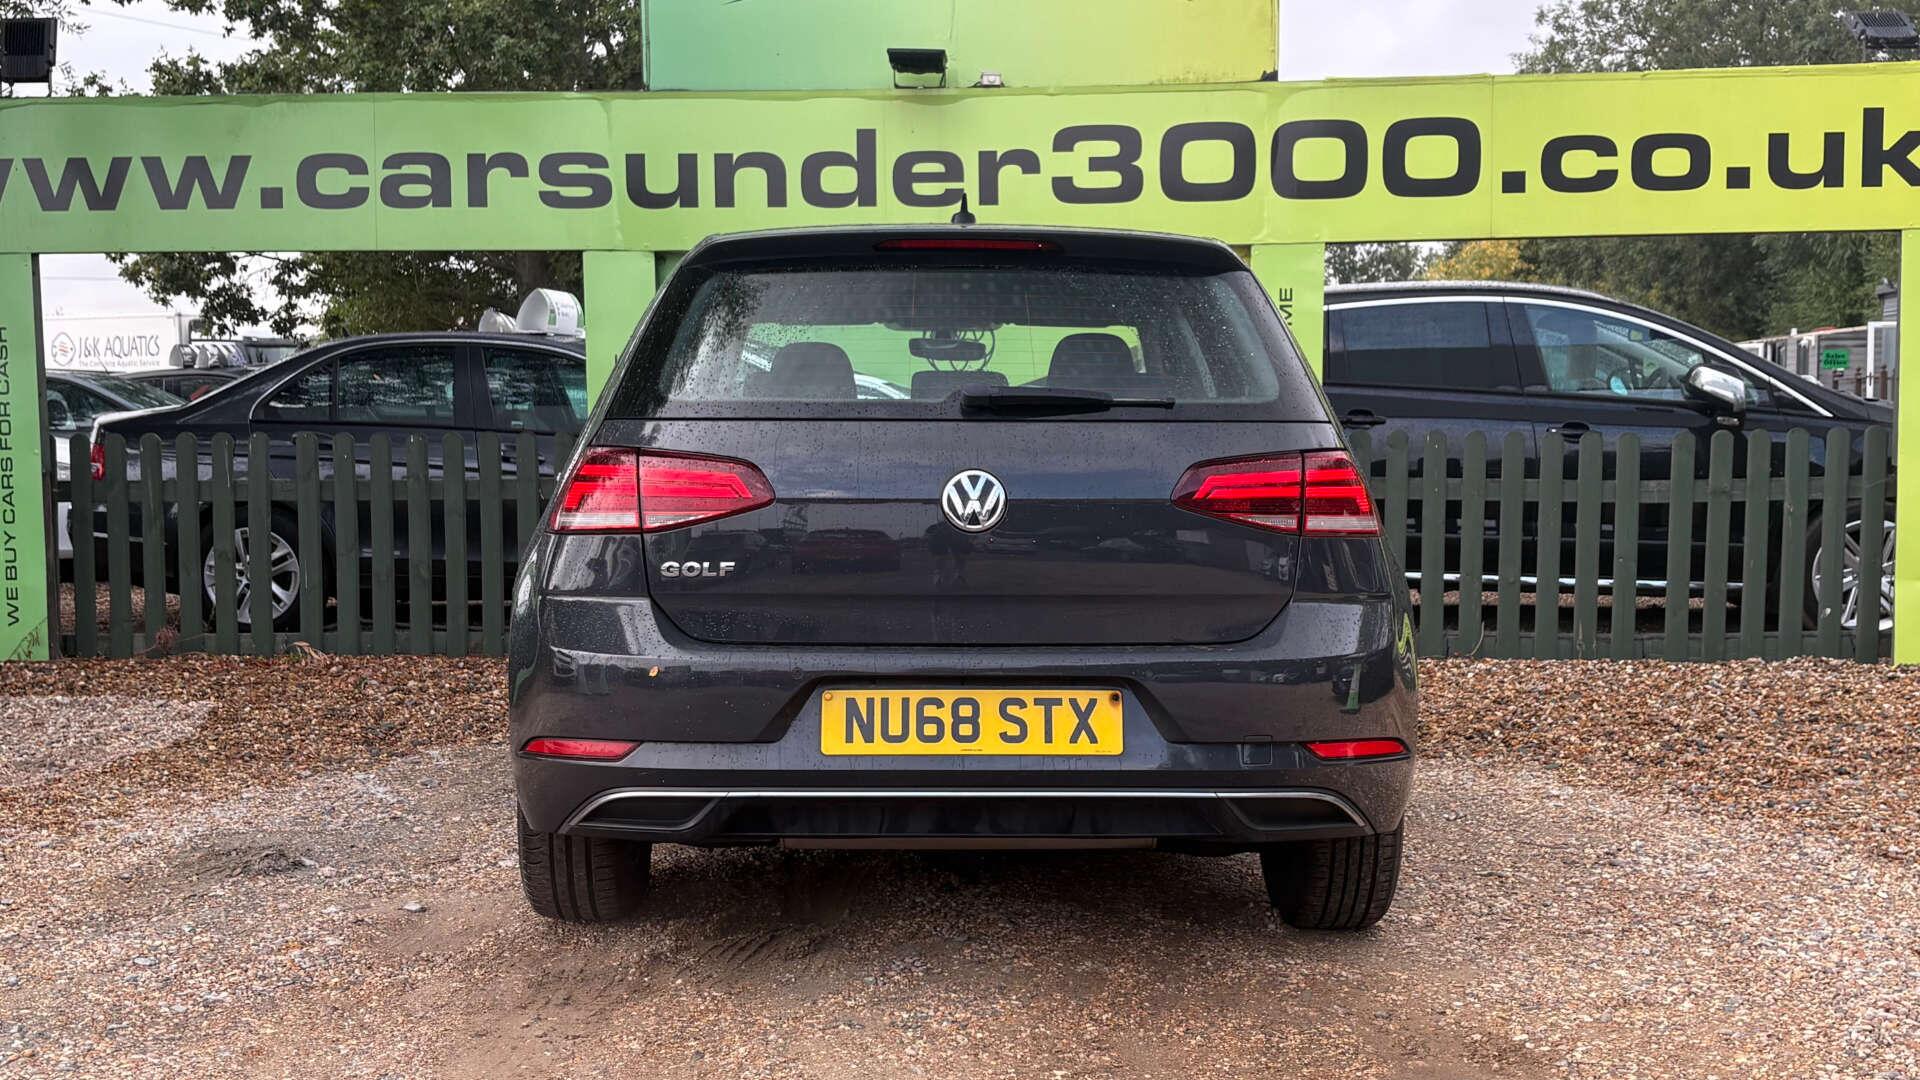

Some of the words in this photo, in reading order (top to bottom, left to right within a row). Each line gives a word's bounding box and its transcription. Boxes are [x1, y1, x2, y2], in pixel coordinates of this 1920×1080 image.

[0, 107, 1920, 212] ww.carsunder3000.co.uk
[104, 335, 160, 358] AQUATICS
[0, 401, 12, 451] FOR
[1, 456, 15, 524] CARS
[4, 531, 17, 581] BUY
[660, 561, 736, 577] GOLF
[6, 587, 20, 627] WE
[844, 697, 981, 744] NU68
[998, 697, 1099, 744] STX
